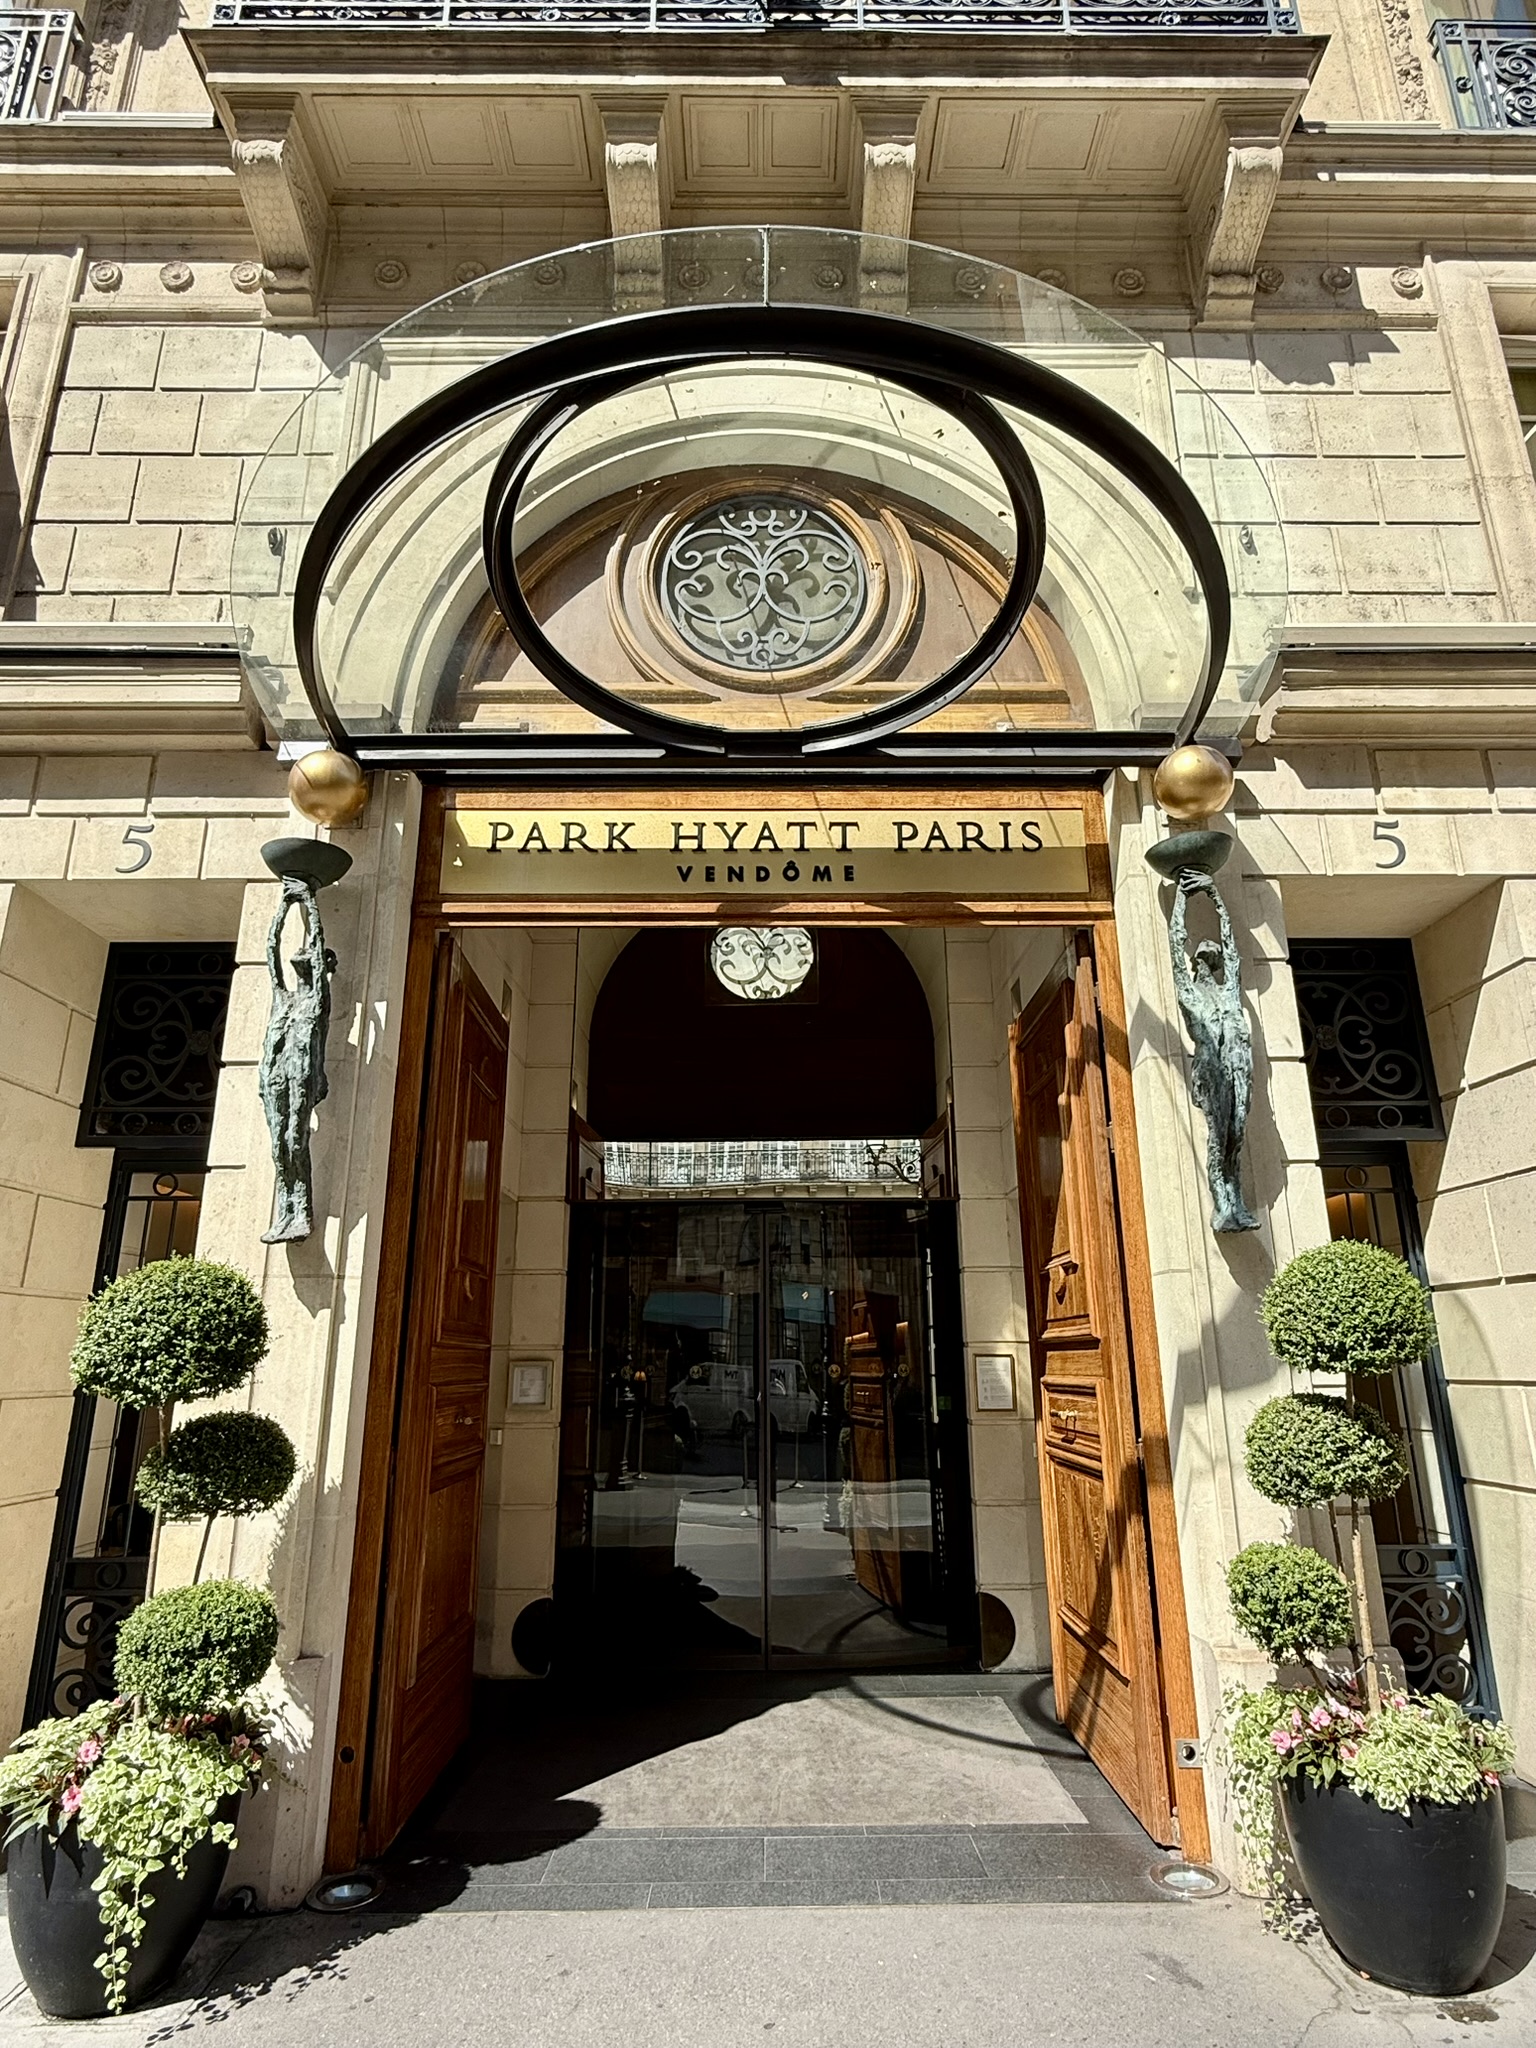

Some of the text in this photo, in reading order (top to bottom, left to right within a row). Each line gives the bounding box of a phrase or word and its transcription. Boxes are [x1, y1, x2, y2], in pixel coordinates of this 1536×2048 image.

[115, 823, 155, 874] 5
[486, 820, 1045, 854] PARK HYATT PARIS
[1373, 819, 1407, 870] 5
[677, 861, 856, 883] VENDÔME
